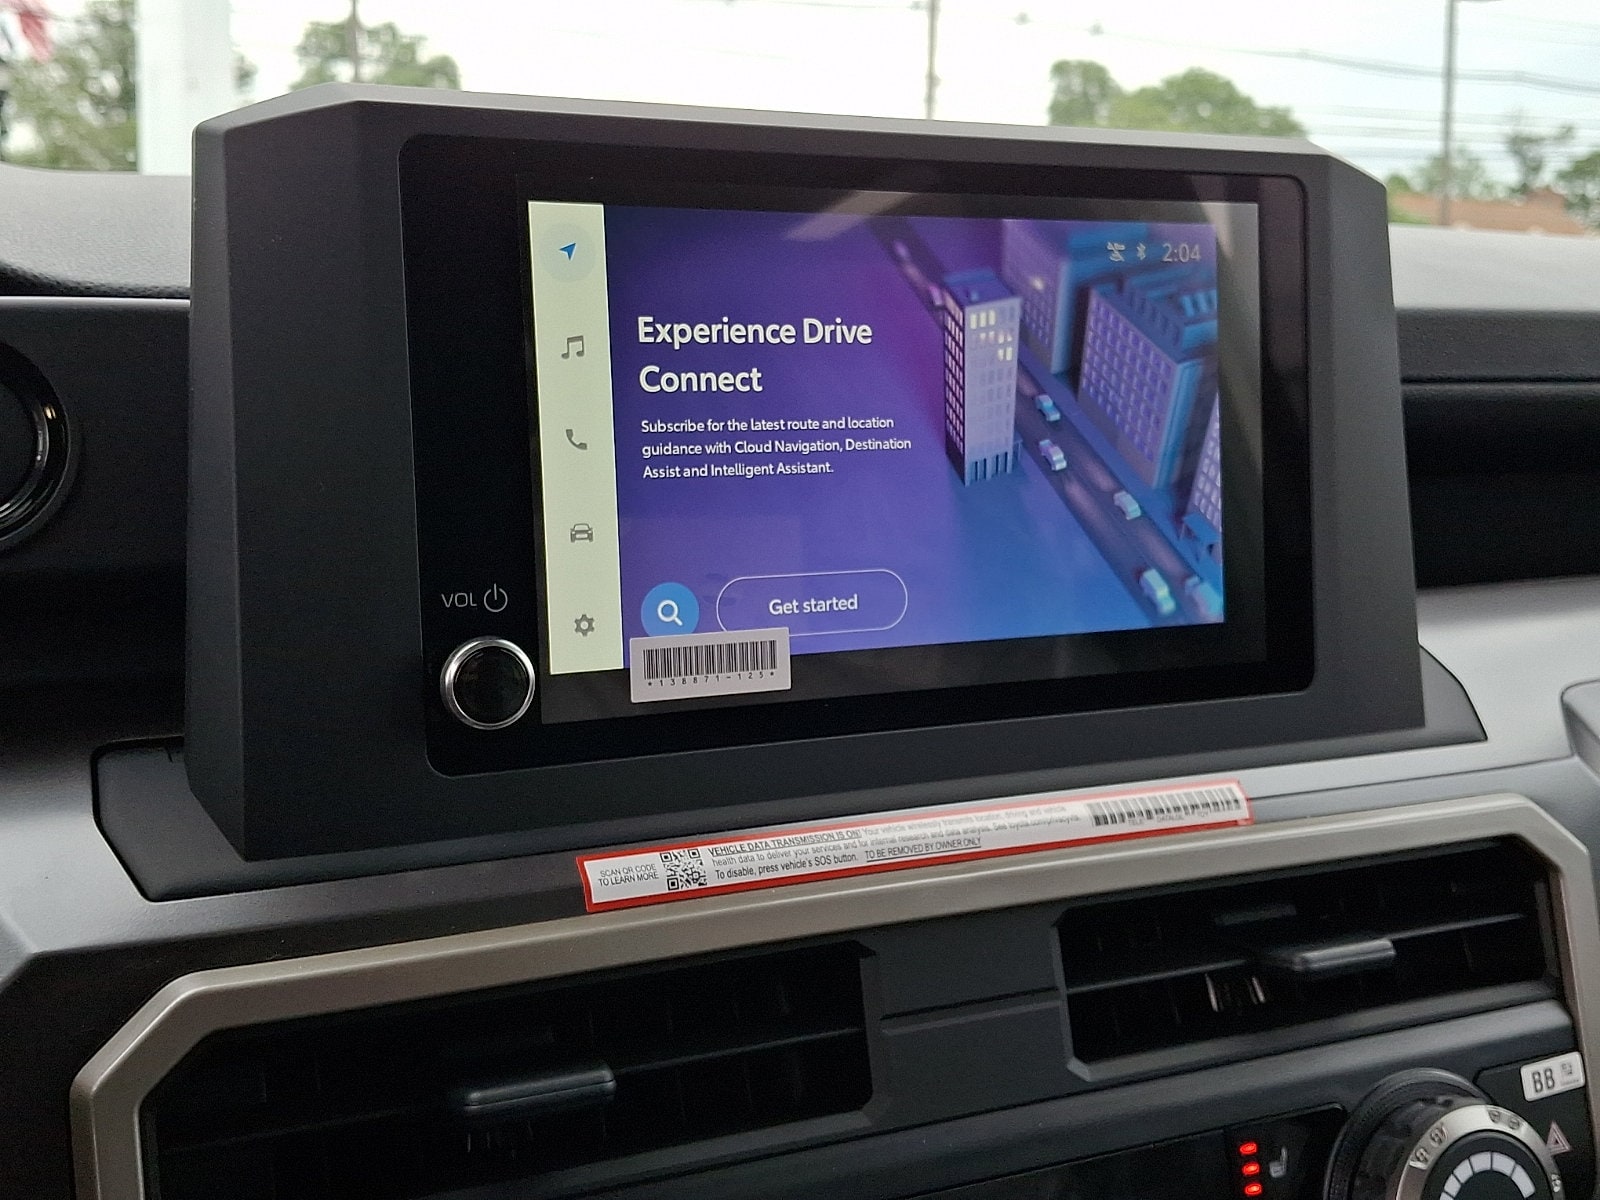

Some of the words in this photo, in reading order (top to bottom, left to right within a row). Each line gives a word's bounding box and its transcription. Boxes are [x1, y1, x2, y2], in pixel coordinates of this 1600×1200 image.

[1162, 243, 1201, 262] 2:04
[637, 316, 796, 350] Experience
[802, 317, 873, 344] Drive
[639, 365, 763, 393] Connect
[641, 420, 705, 433] Subscribe
[706, 418, 726, 432] for
[727, 418, 748, 432] the
[750, 418, 786, 431] latest
[787, 418, 820, 430] route
[822, 416, 846, 430] and
[848, 416, 894, 429] location
[642, 442, 702, 459] guidance
[704, 441, 732, 455] with
[734, 441, 772, 454] Cloud
[774, 439, 843, 456] Navigation,
[845, 438, 912, 451] Destination
[643, 465, 682, 479] Assist
[683, 464, 708, 478] and
[710, 463, 774, 479] Intelligent
[776, 462, 834, 475] Assistant.
[441, 592, 477, 608] VOL
[768, 598, 800, 615] Get
[803, 593, 858, 613] started
[708, 843, 750, 857] VEHICLE
[747, 841, 770, 852] DATA
[771, 832, 836, 848] TRANSMISSION
[836, 831, 846, 840] IS
[712, 857, 737, 867] health
[738, 854, 755, 864] data
[756, 852, 764, 862] to
[767, 850, 792, 860] deliver
[794, 848, 811, 859] your
[811, 844, 842, 854] services
[843, 840, 857, 850] and
[716, 870, 725, 880] To
[726, 866, 757, 879] disable,
[758, 864, 779, 875] press
[781, 858, 813, 871] vehicle's
[814, 855, 832, 866] SOS
[865, 850, 875, 860] TO
[877, 848, 887, 858] BE
[888, 844, 924, 856] REMOVED
[924, 842, 935, 852] BY
[936, 839, 962, 850] OWNER
[963, 836, 981, 847] ONLY
[598, 878, 609, 886] TO
[611, 874, 636, 886] LEARN
[637, 871, 660, 881] MORE
[600, 868, 621, 878] SCAN
[622, 866, 634, 874] QR
[635, 863, 657, 873] CODE
